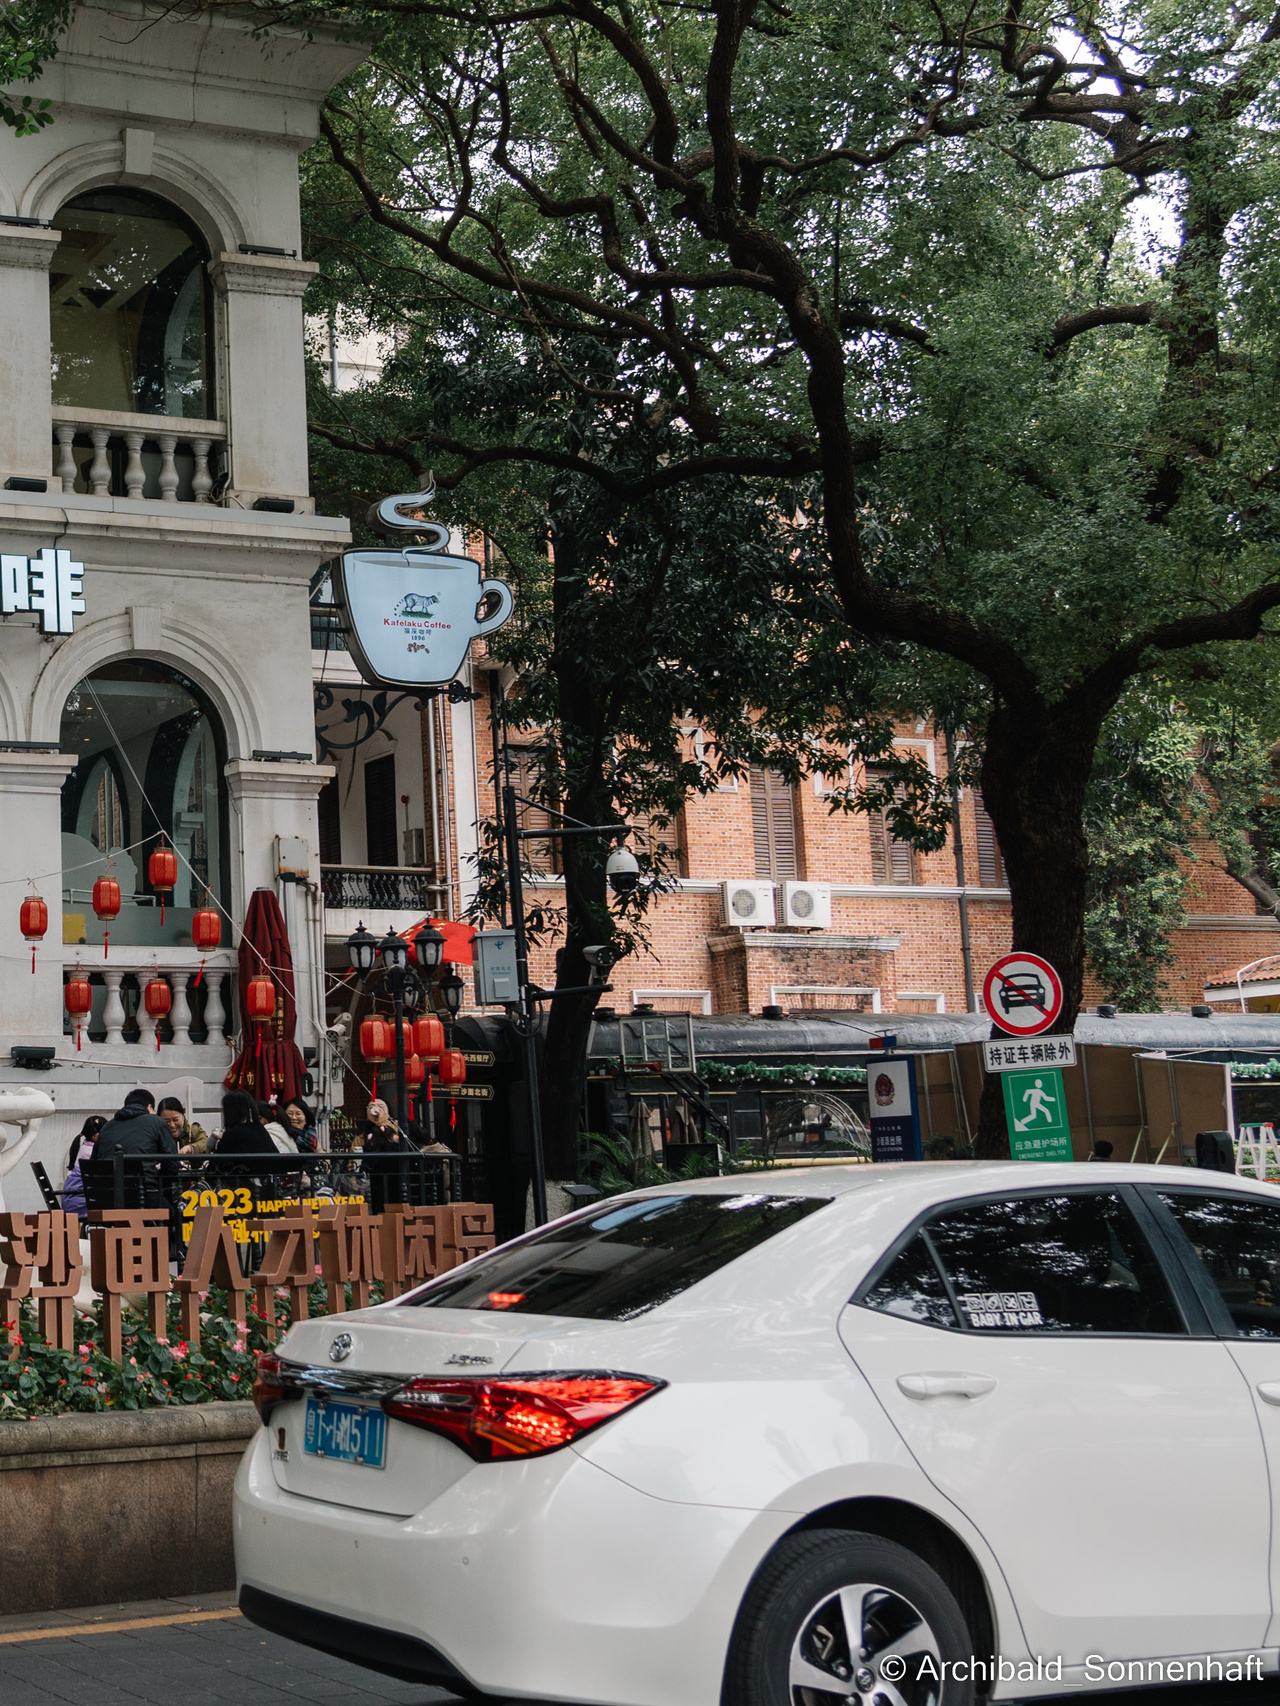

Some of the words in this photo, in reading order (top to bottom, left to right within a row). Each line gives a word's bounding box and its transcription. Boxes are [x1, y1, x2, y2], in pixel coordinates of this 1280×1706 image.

[383, 618, 422, 627] Kafelaku
[424, 620, 451, 629] Coffee
[989, 1042, 1071, 1066] 持证车辆除外
[180, 1187, 253, 1217] 2023
[970, 1312, 1003, 1327] BABY
[1003, 1312, 1019, 1326] IN
[1019, 1311, 1044, 1326] CAR
